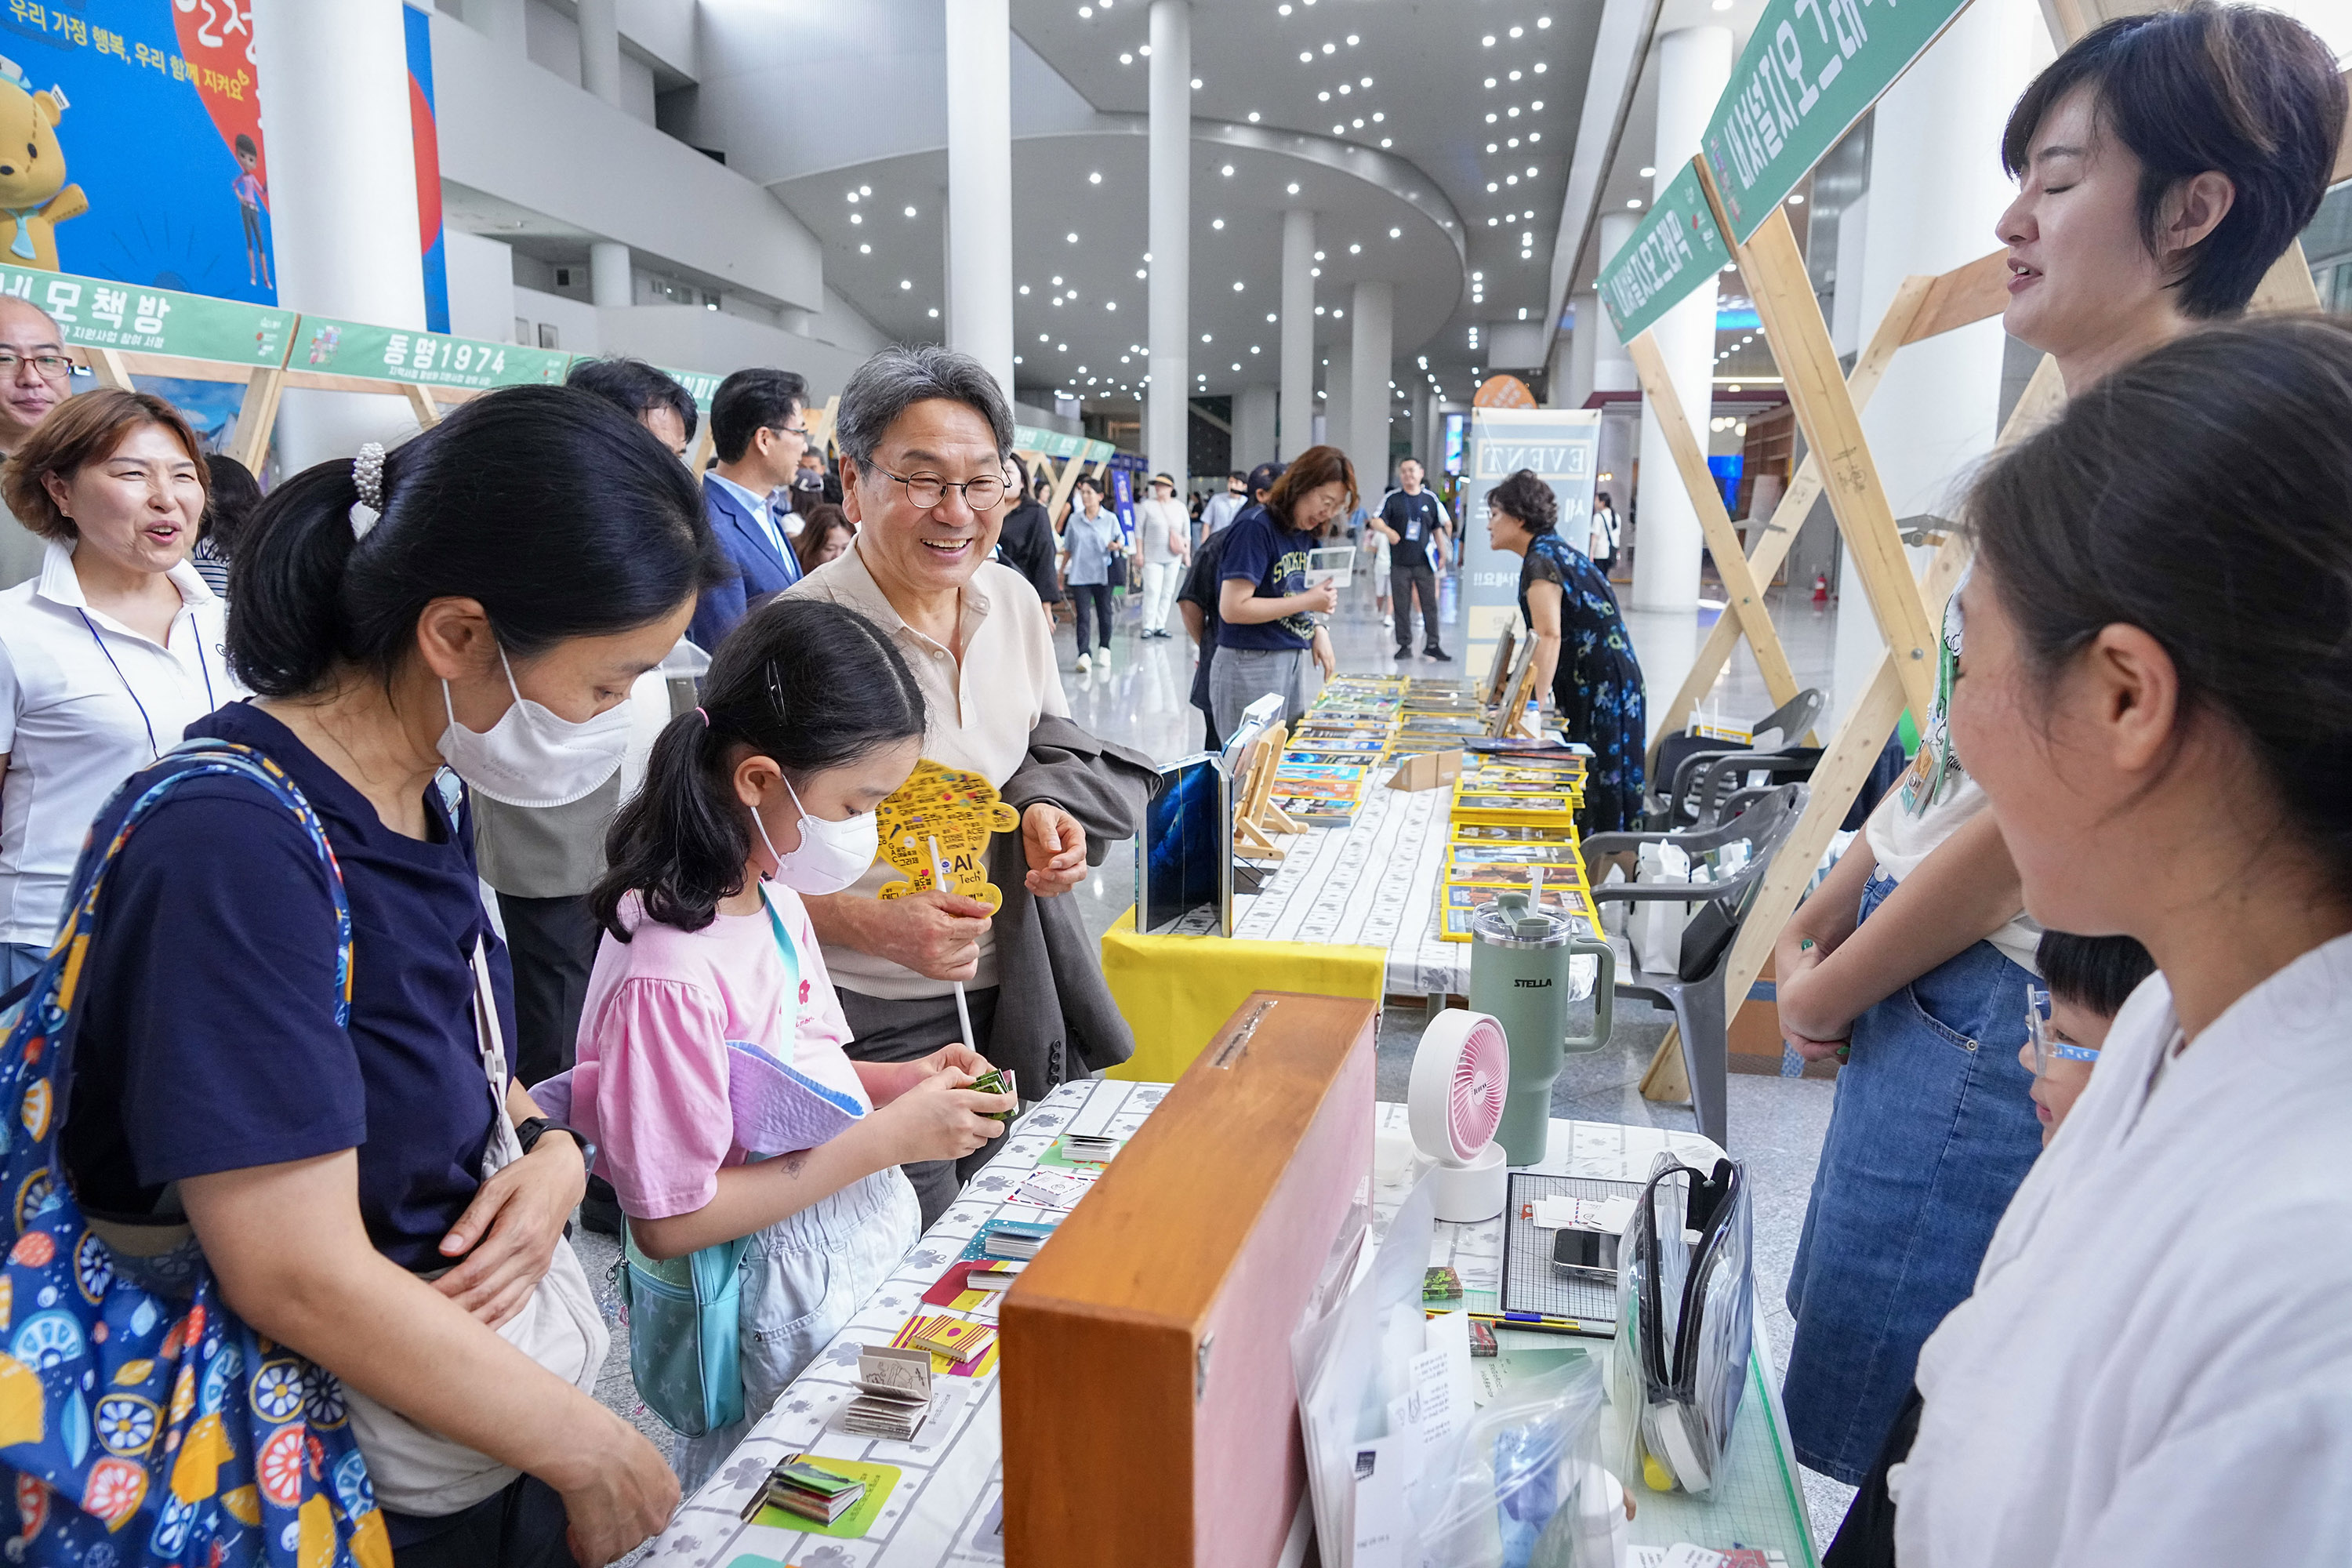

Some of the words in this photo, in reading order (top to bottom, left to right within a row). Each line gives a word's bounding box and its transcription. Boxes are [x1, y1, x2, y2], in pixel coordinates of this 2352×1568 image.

[9, 0, 47, 31] 우리
[52, 11, 89, 45] 가정
[92, 24, 131, 64] 행복,
[134, 42, 165, 74] 우리
[169, 55, 200, 87] 함께
[204, 68, 245, 101] 지켜요
[383, 333, 506, 375] 동명1974
[954, 853, 973, 873] AI
[1514, 978, 1552, 989] STELLA
